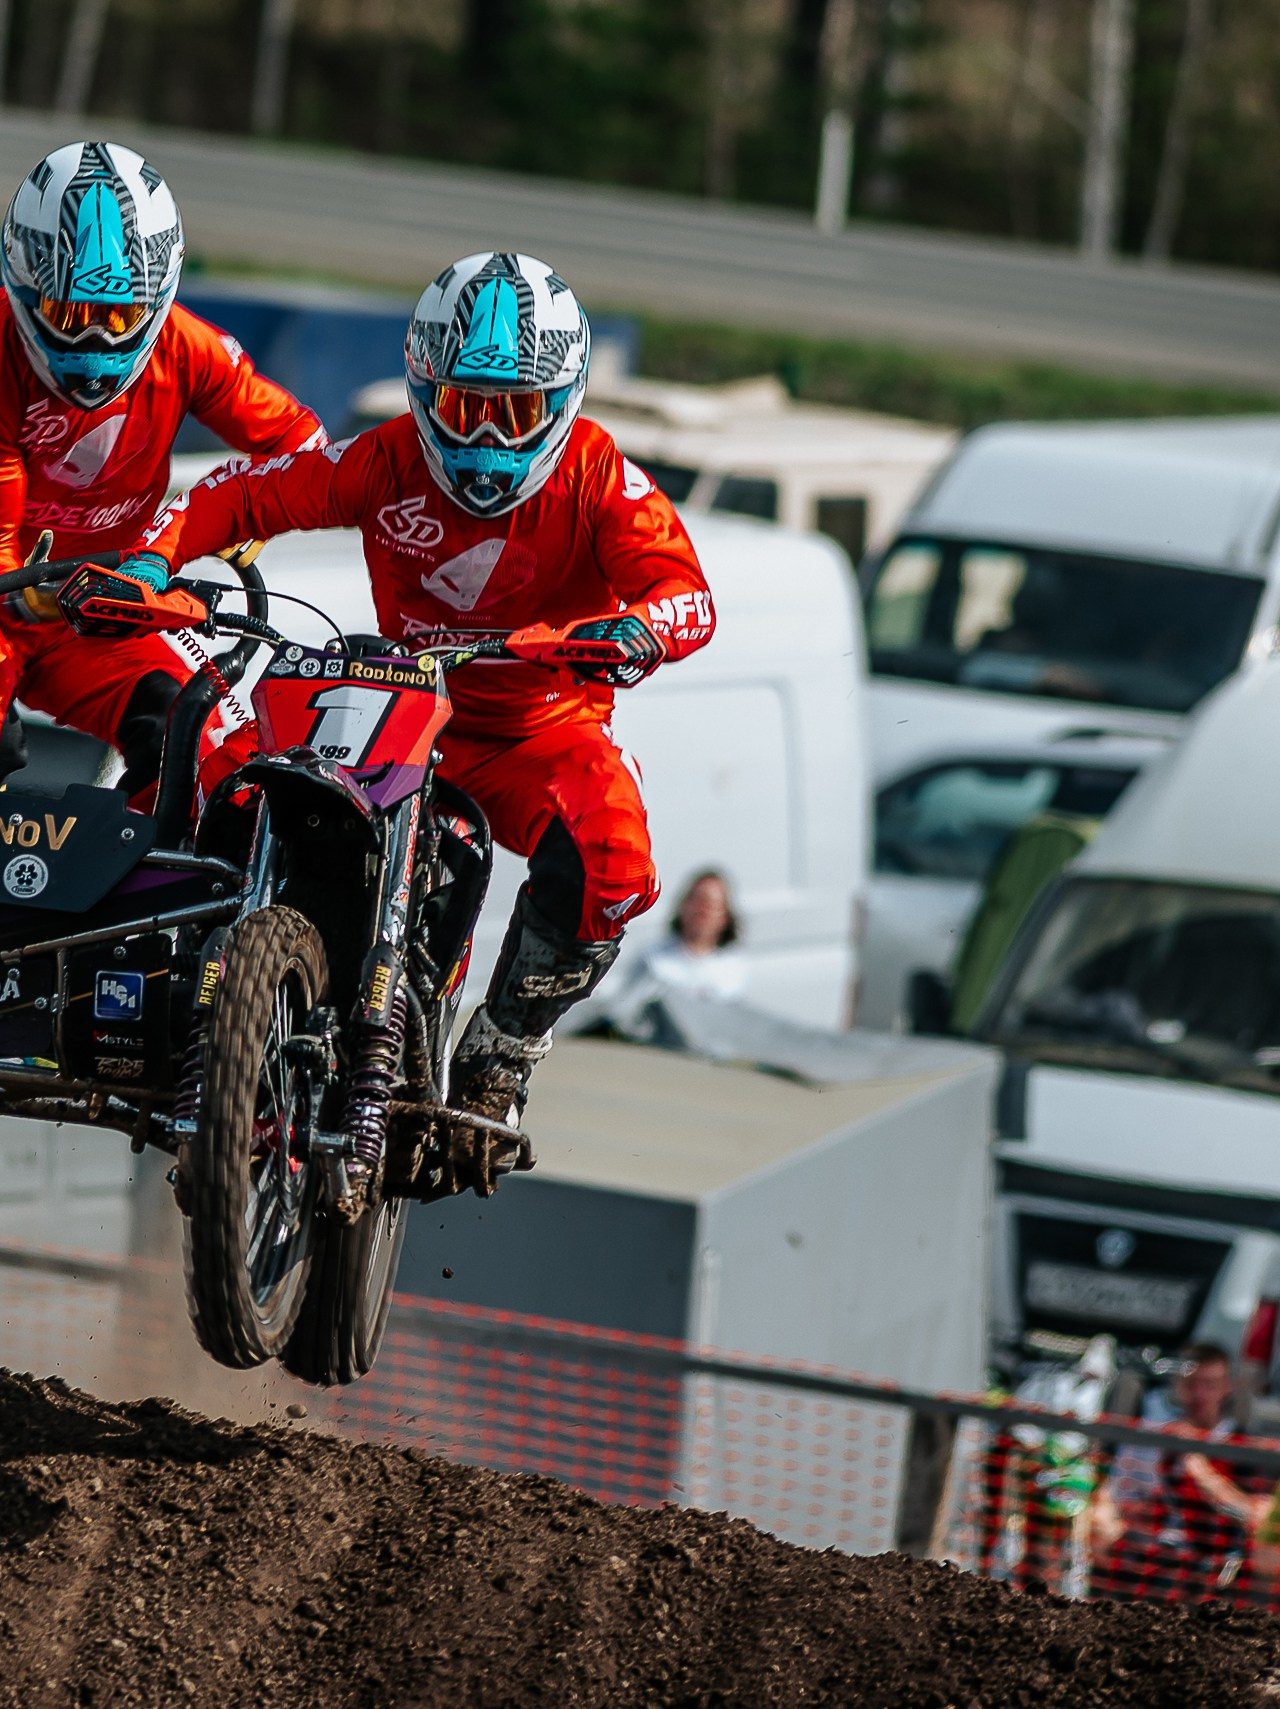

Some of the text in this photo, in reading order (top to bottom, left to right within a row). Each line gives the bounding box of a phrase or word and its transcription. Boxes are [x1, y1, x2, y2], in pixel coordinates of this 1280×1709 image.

[84, 603, 154, 622] ACERBIS
[305, 684, 402, 770] 1
[199, 960, 221, 1006] REIGER
[369, 964, 392, 1012] REIGER
